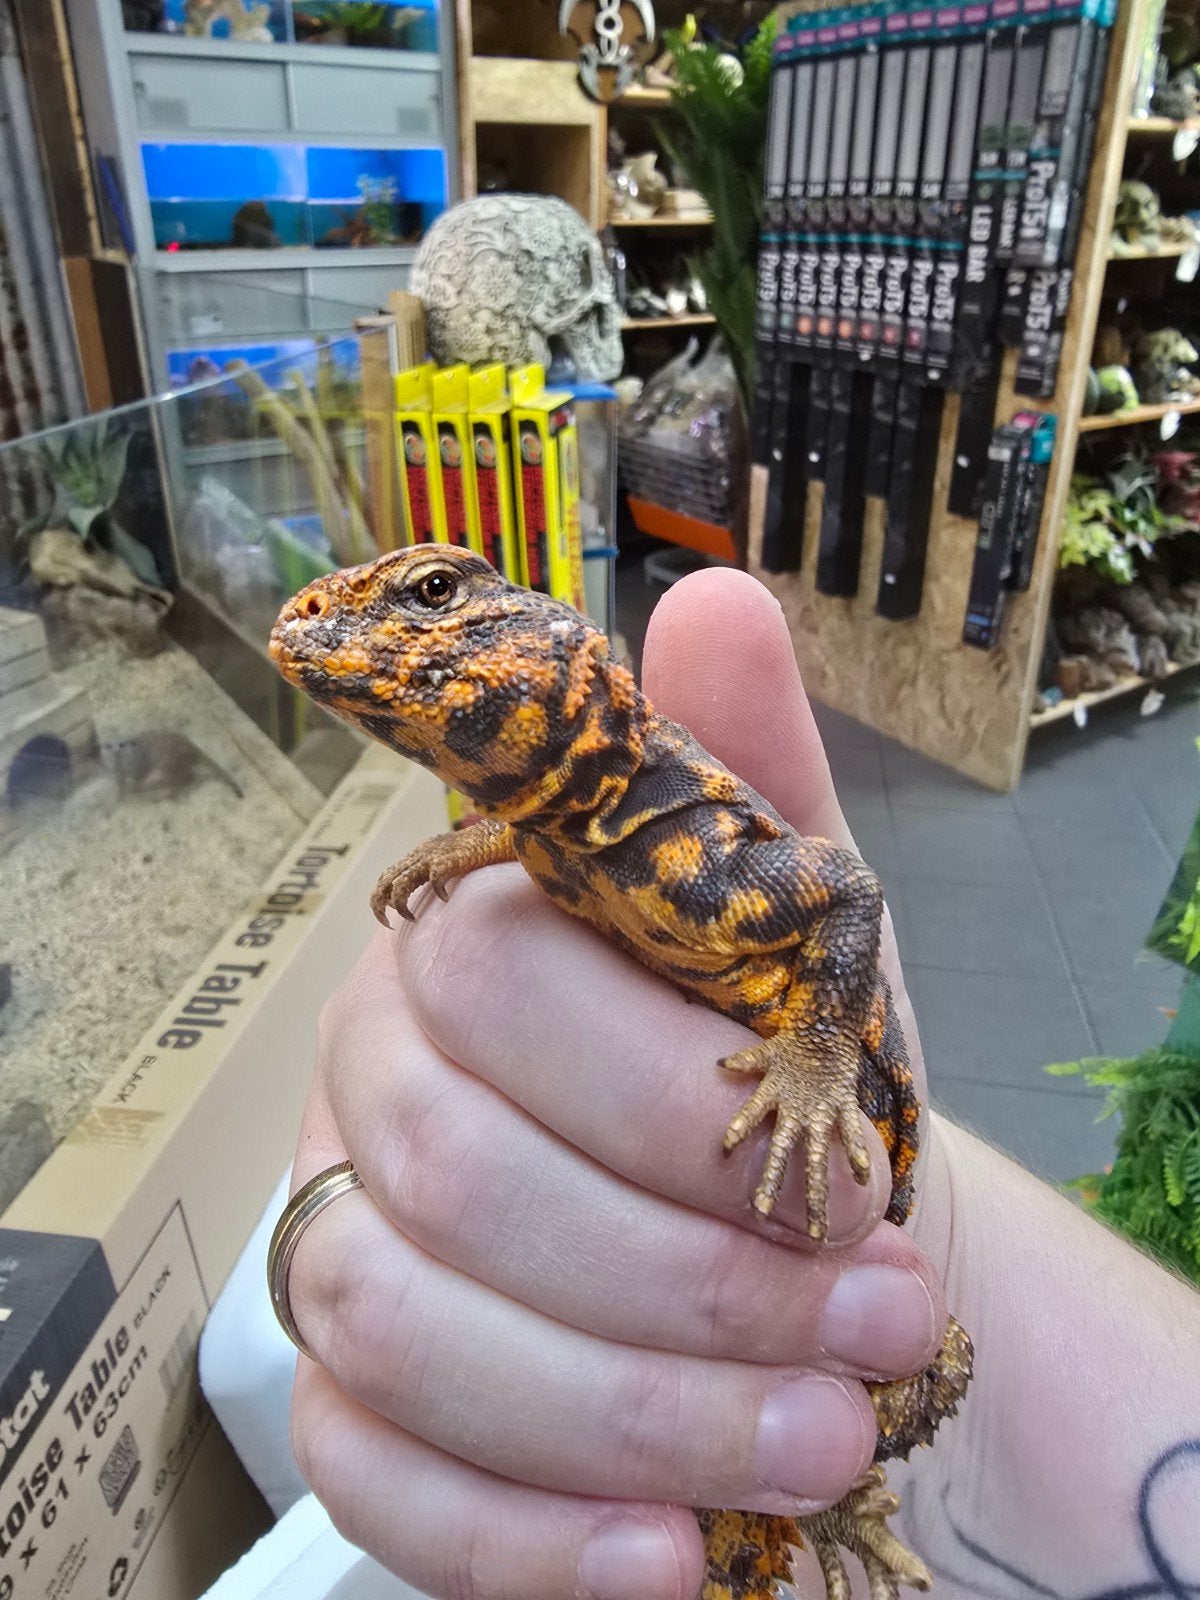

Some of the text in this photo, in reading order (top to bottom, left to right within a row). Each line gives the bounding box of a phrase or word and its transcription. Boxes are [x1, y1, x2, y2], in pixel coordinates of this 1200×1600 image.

[965, 205, 993, 283] LED BAR
[157, 843, 350, 1049] Tortoise Table
[111, 1055, 157, 1104] BLACK
[64, 1326, 130, 1431] Table
[133, 1265, 172, 1330] BLACK
[19, 1536, 38, 1571] x
[42, 1476, 69, 1529] 61
[74, 1443, 92, 1477] x
[94, 1345, 148, 1438] 63cm
